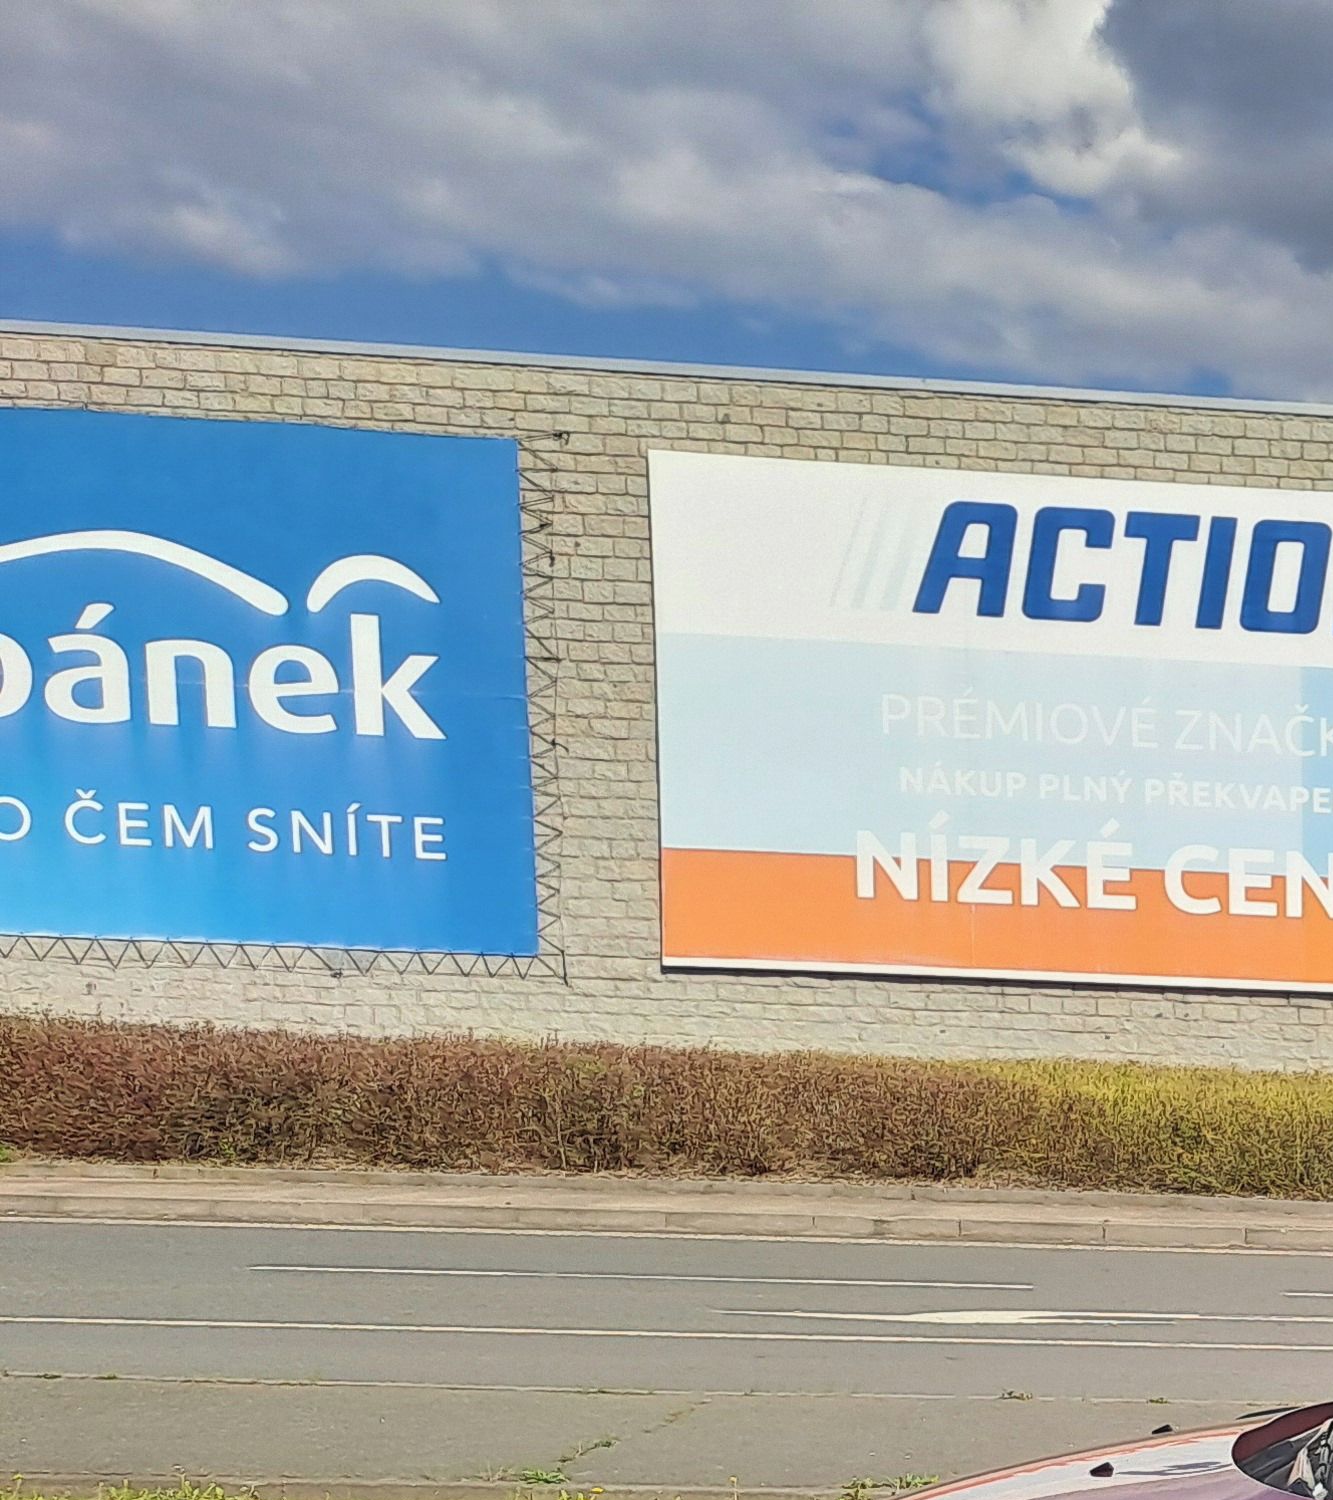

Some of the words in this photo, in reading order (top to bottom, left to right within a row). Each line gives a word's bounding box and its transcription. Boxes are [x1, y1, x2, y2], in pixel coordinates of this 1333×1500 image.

[880, 686, 1159, 749] PRÉMIOVÉ
[899, 761, 1027, 799] NÁKUP
[1039, 770, 1132, 804] PLNÝ
[64, 788, 214, 850] ČEM
[247, 803, 448, 861] SNÍTE
[856, 810, 1137, 911] NÍZKÉ
